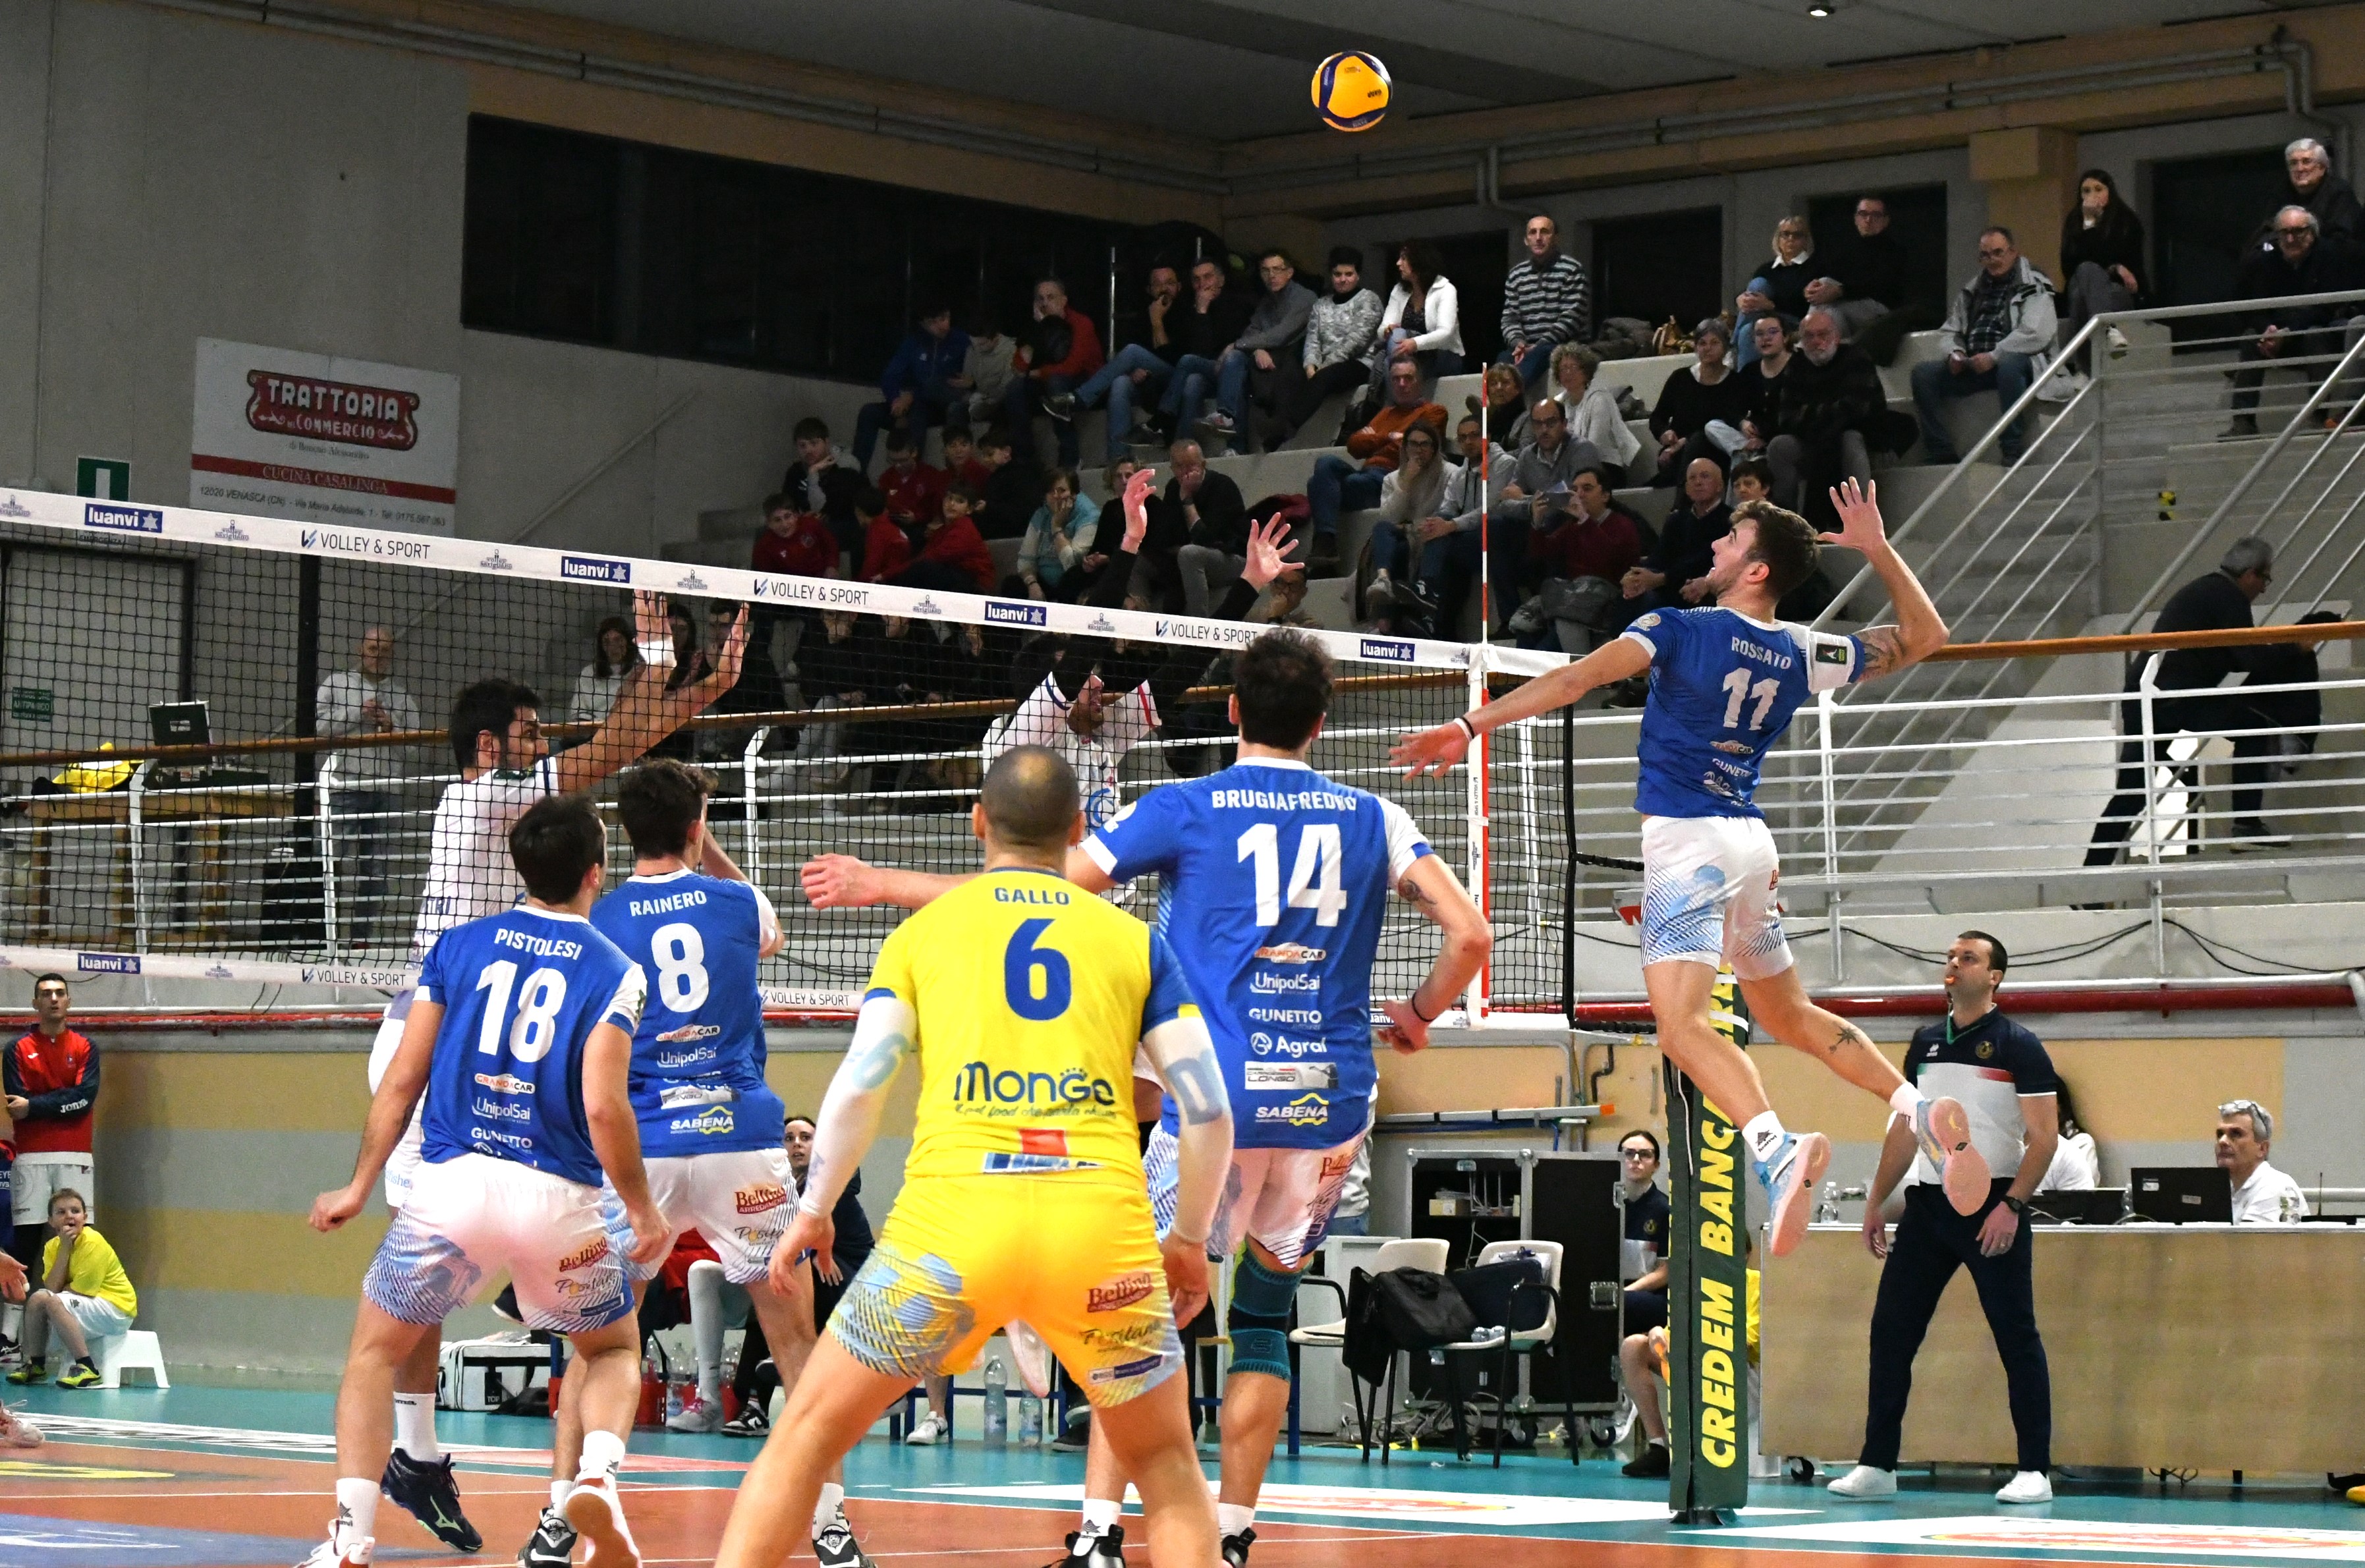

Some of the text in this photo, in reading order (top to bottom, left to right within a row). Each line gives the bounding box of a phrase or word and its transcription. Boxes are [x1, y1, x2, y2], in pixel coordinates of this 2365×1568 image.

[267, 379, 399, 422] TRATTORIA
[296, 414, 375, 439] COMMERCIO
[264, 465, 388, 494] CUCINA CASALINGA
[200, 486, 224, 497] 12020
[227, 490, 265, 503] VENASCA
[88, 507, 139, 527] luanvi
[321, 533, 431, 559] VOLLEY & SPORT
[564, 559, 609, 578] luanvi
[771, 581, 869, 605] VOLLEY & SPORT
[988, 604, 1028, 621] luanvi
[1171, 623, 1258, 643] VOLLEY & SPORT
[1362, 642, 1399, 658] luanvi
[1731, 636, 1792, 670] ROSSATO
[1722, 667, 1781, 731] 11
[1237, 823, 1347, 928] 14
[629, 889, 708, 917] RAINERO
[994, 887, 1070, 905] GALLO
[494, 928, 583, 961] PISTOLESI
[80, 957, 122, 971] luanvi
[650, 922, 710, 1013] 8
[1005, 918, 1072, 1021] 6
[318, 970, 406, 986] VOLLEY & SPORT
[1255, 972, 1321, 994] UnipolSai
[771, 992, 849, 1007] VOLLEY & SPORT
[476, 959, 567, 1063] 18
[1248, 1007, 1322, 1024] GUNETTO
[659, 1047, 717, 1068] UnipolSai
[476, 1075, 532, 1092] GRANDACAR
[476, 1096, 531, 1120] UnipolSai
[1255, 1106, 1328, 1118] SABENA
[671, 1115, 734, 1130] SABENA
[471, 1127, 533, 1150] GUNETTO
[1701, 1278, 1736, 1469] CREDEM
